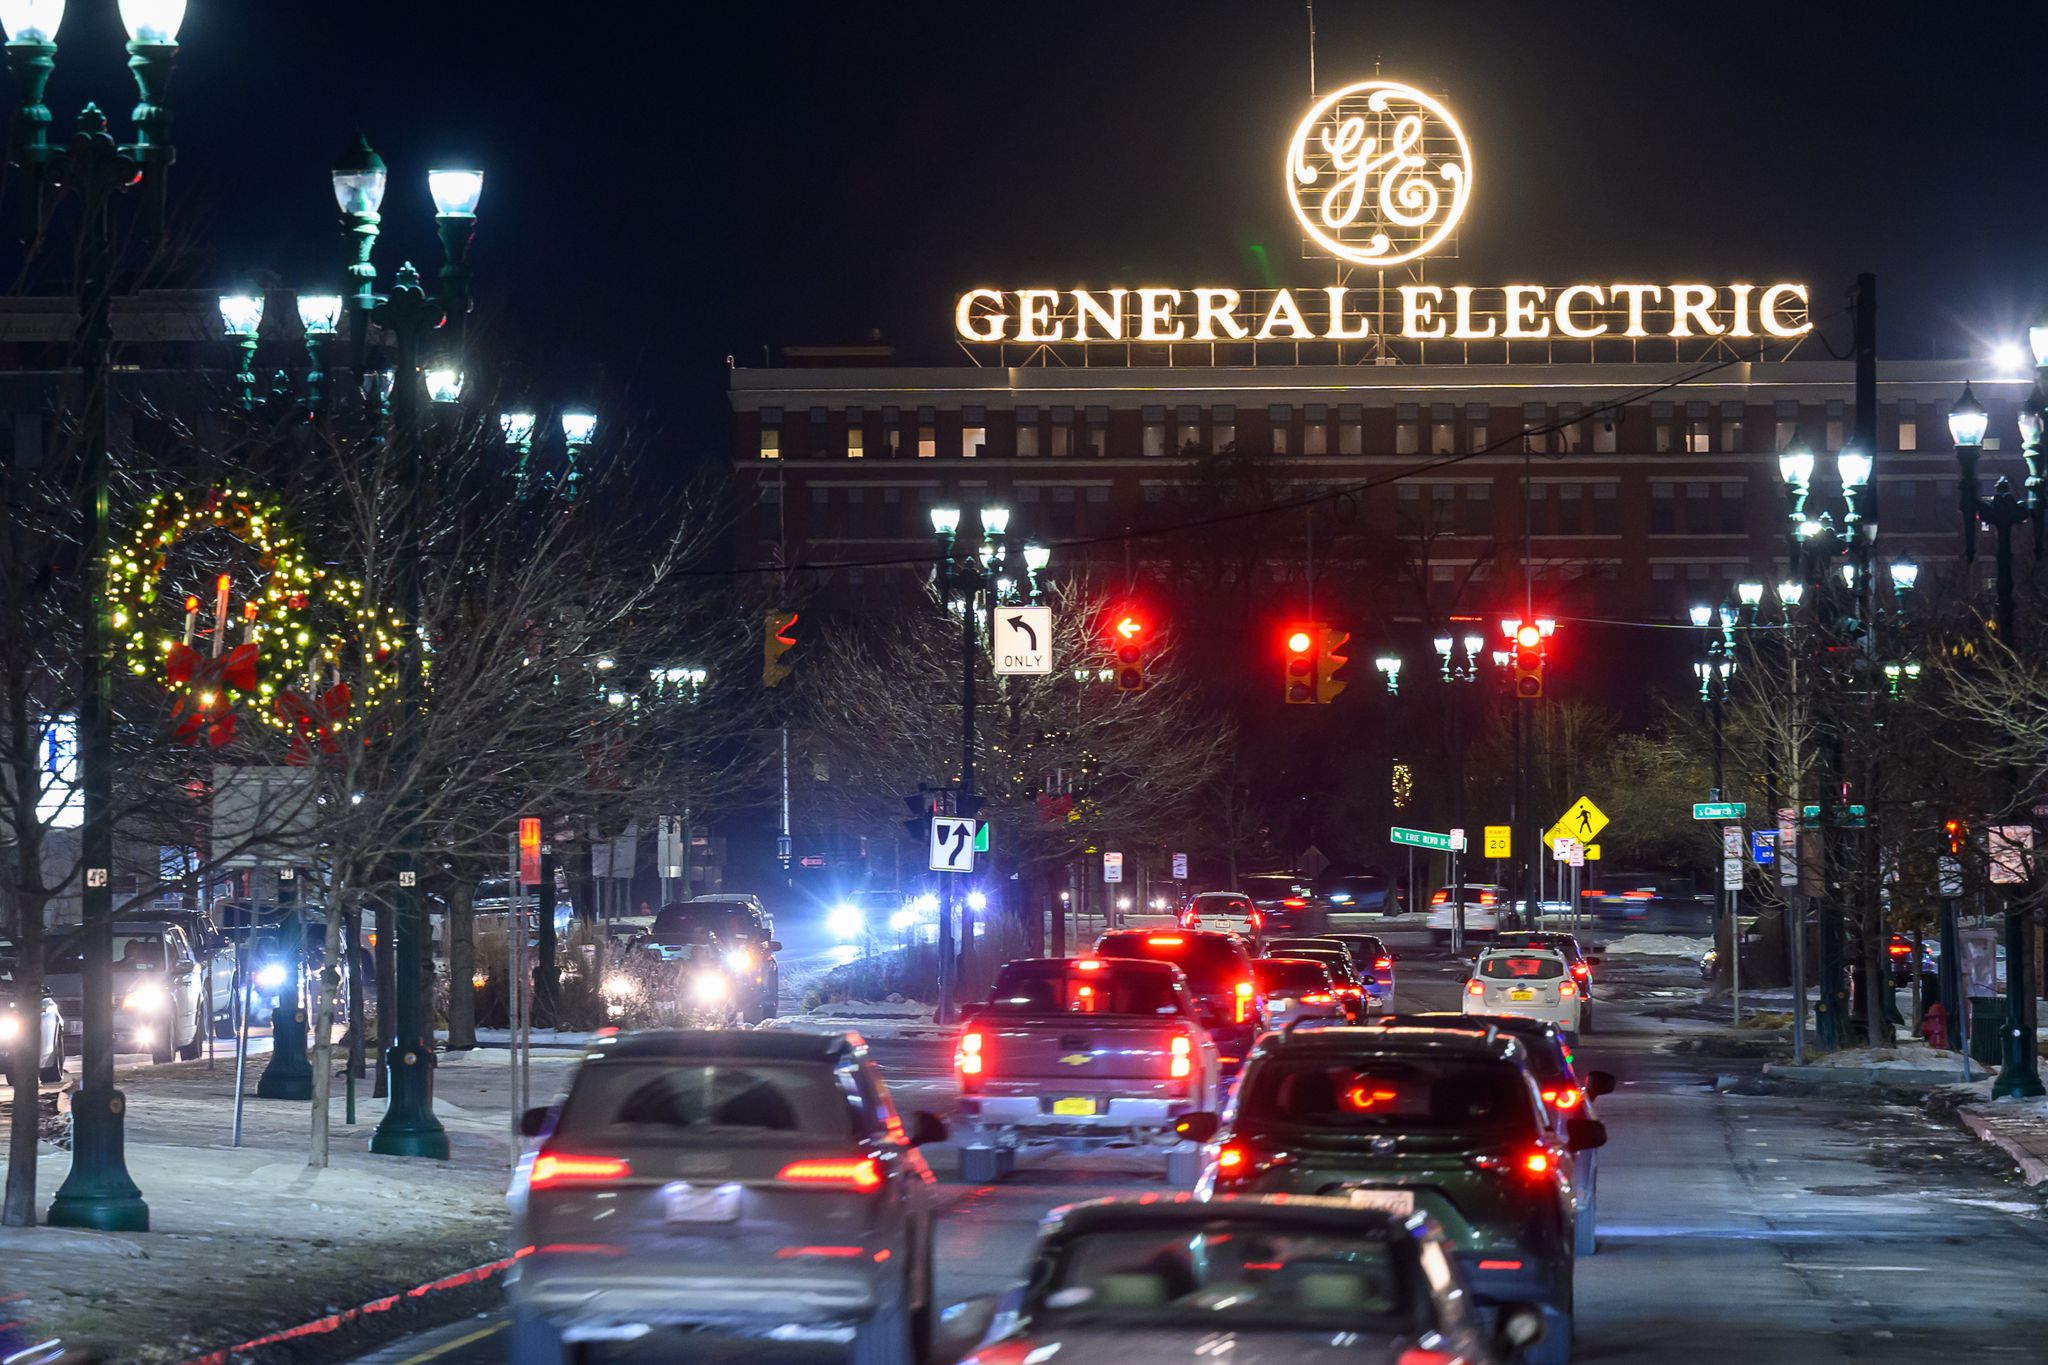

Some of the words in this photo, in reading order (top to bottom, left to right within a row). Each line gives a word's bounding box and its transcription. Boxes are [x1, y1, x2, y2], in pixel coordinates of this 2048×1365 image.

[956, 287, 1369, 341] GENERAL
[1397, 284, 1815, 337] ELECTRIC
[1004, 655, 1042, 668] ONLY
[1405, 833, 1420, 843] ERIE
[1490, 840, 1506, 849] 20
